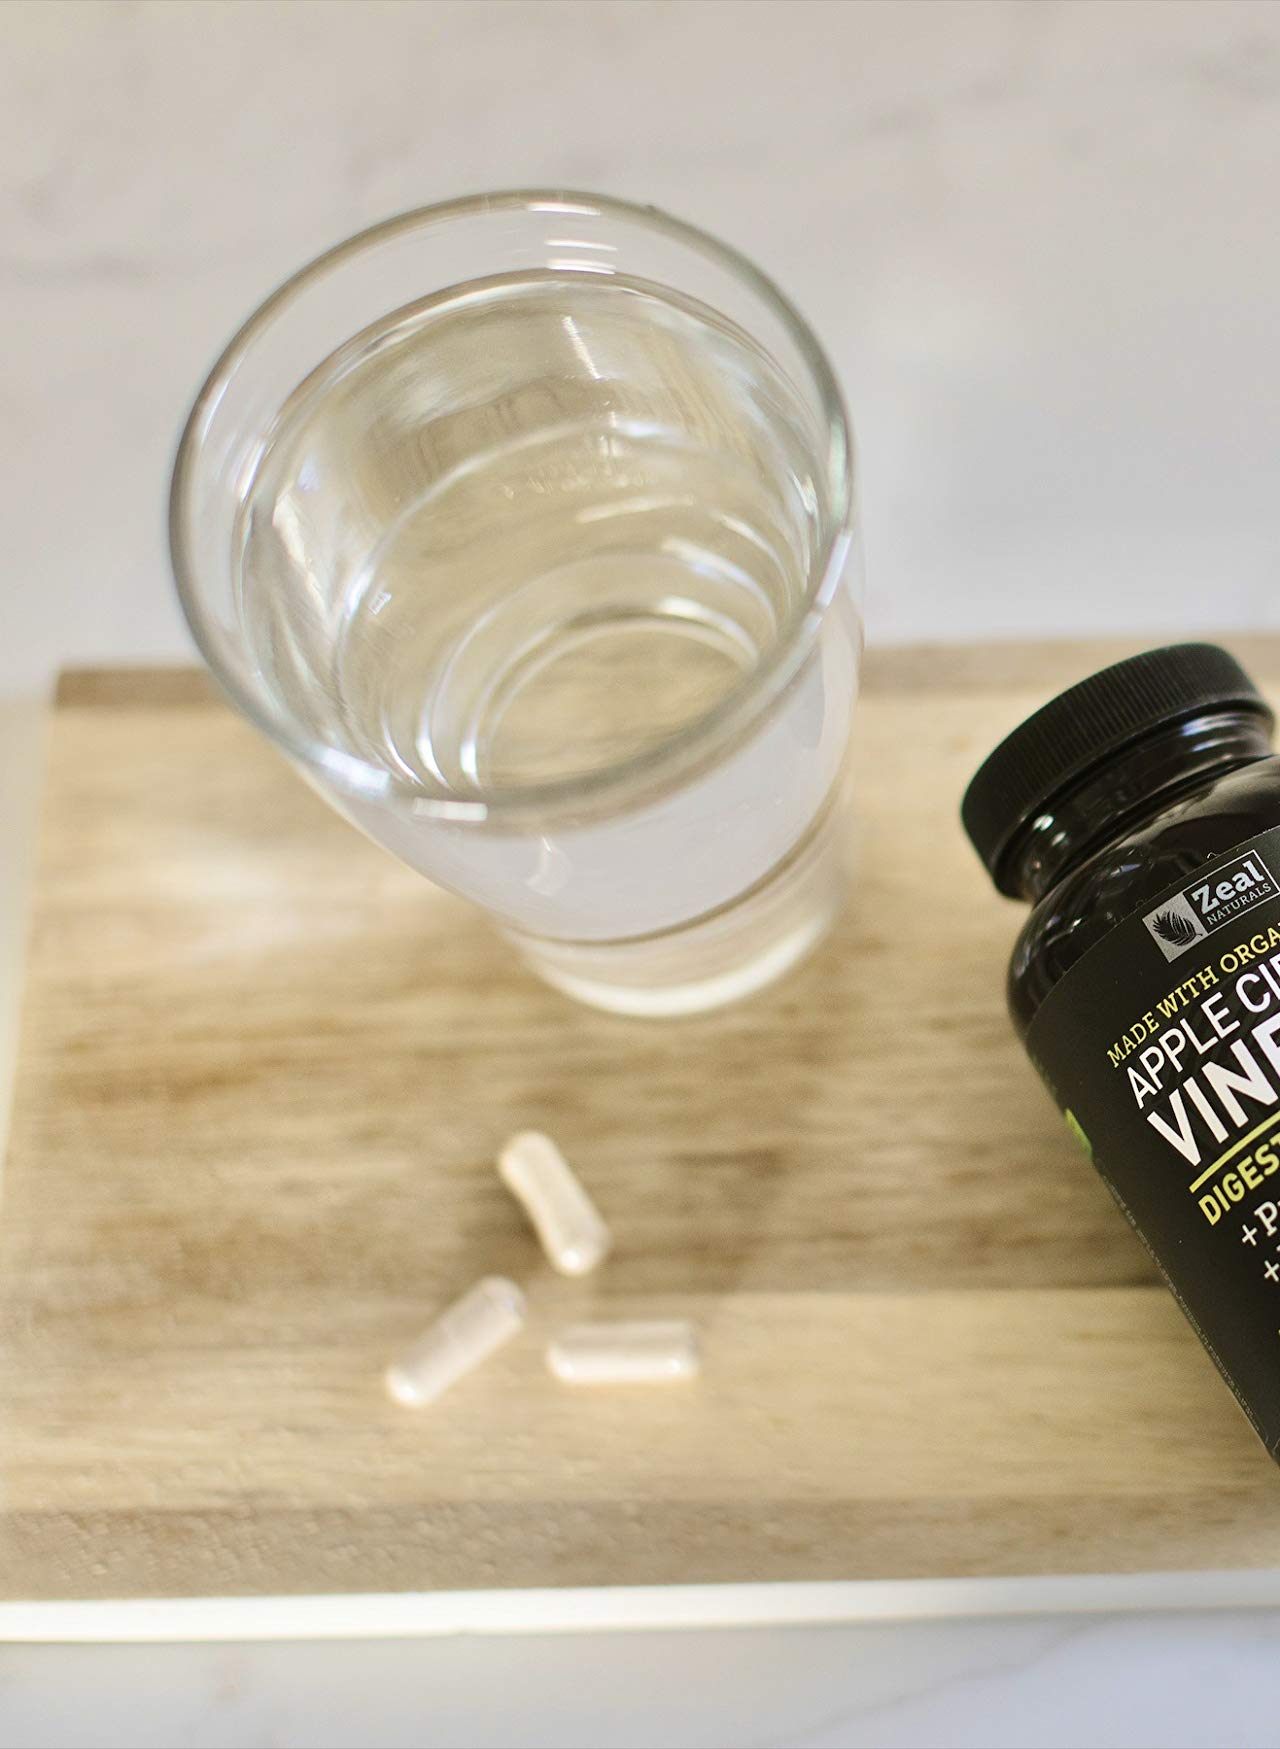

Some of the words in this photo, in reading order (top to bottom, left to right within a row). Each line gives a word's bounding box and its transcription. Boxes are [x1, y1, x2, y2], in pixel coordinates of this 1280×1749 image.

[1192, 860, 1266, 915] Zeal
[1206, 881, 1272, 926] NATURALS
[1106, 1011, 1160, 1068] MADE
[1156, 965, 1219, 1019] WITH
[1125, 991, 1241, 1109] APPLE
